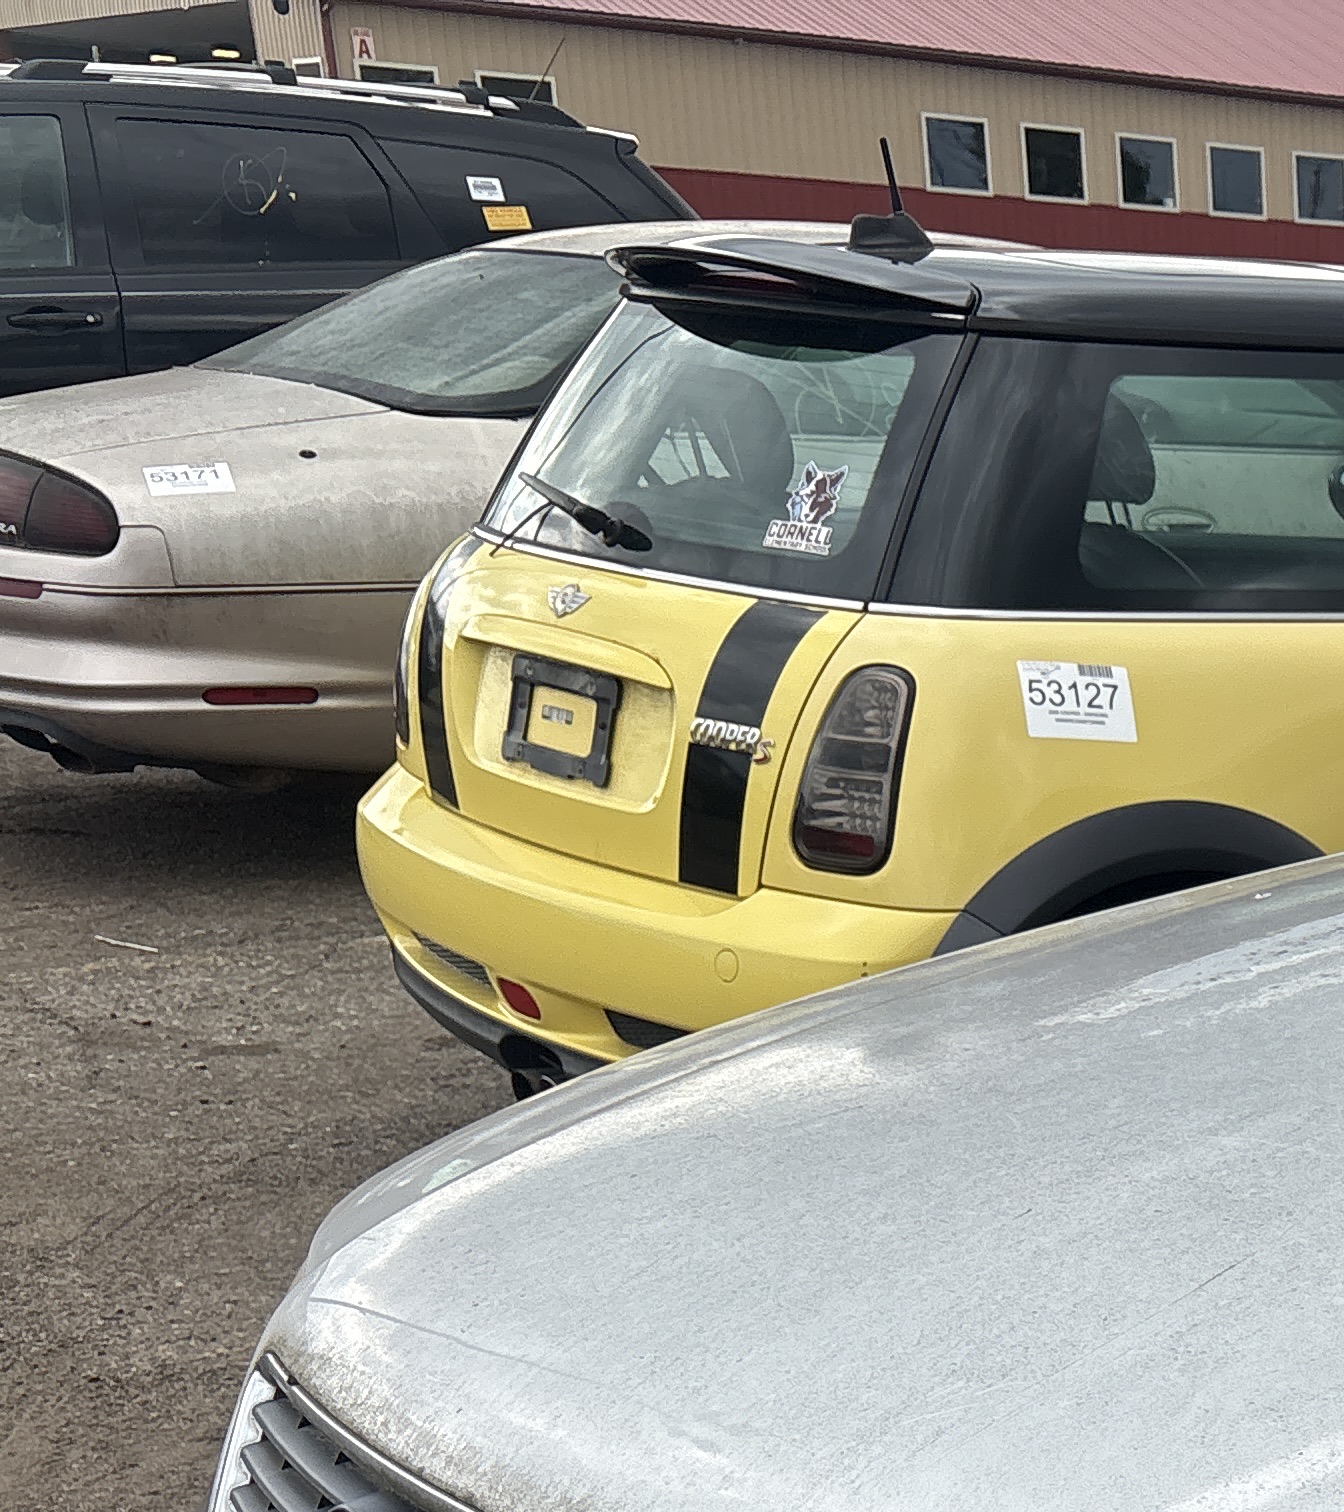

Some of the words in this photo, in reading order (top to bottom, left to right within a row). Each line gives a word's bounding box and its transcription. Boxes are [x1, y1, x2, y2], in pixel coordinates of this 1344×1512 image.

[150, 469, 220, 484] 53171
[767, 521, 833, 546] CORNELL
[1028, 679, 1119, 711] 53127
[690, 717, 761, 752] COOPER
